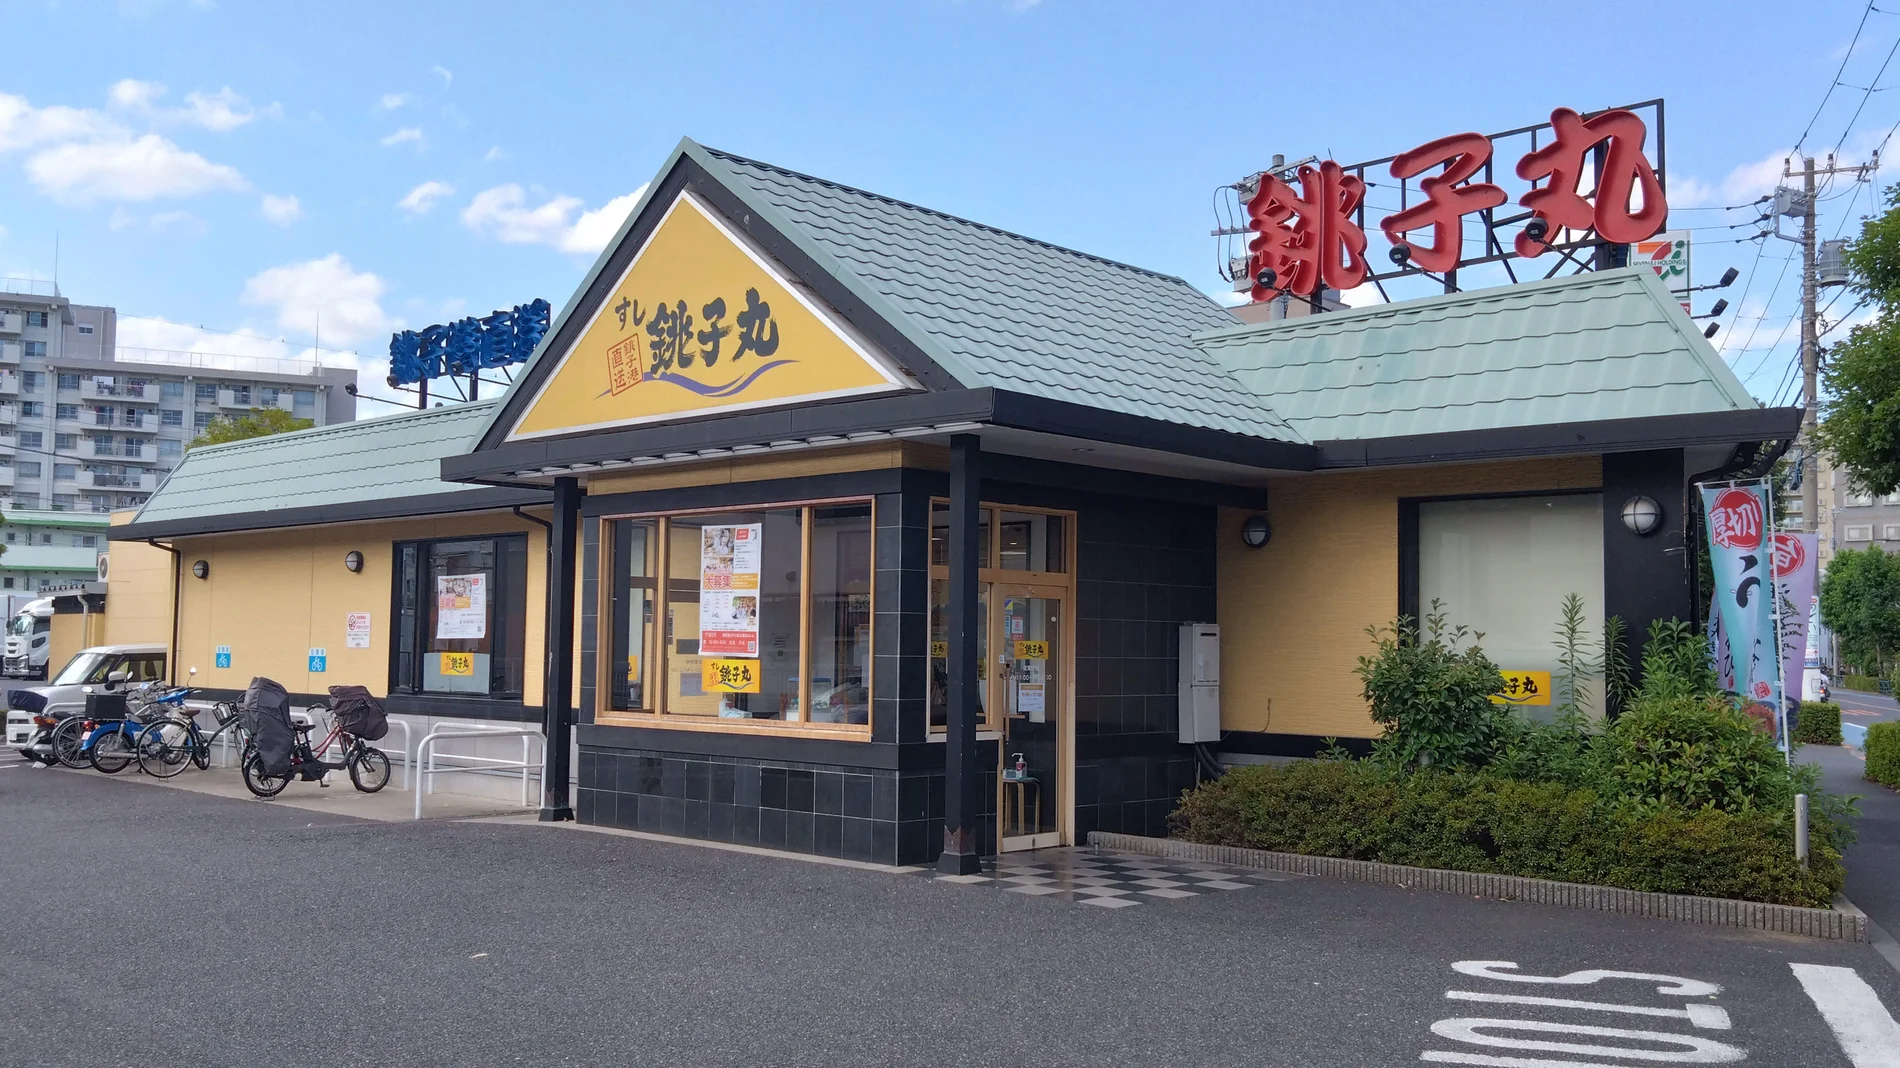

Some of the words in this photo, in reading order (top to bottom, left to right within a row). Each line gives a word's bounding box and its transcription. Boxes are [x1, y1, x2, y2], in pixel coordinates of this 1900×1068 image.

[1247, 106, 1668, 302] 銚子丸
[615, 296, 646, 331] すし
[646, 287, 780, 375] 銚子丸
[612, 347, 627, 390] 直送
[623, 340, 639, 384] 銚子港
[704, 575, 732, 589] 大募集
[719, 664, 752, 682] 銚子丸
[1501, 676, 1538, 694] 子丸
[1420, 960, 1749, 1068] STO
